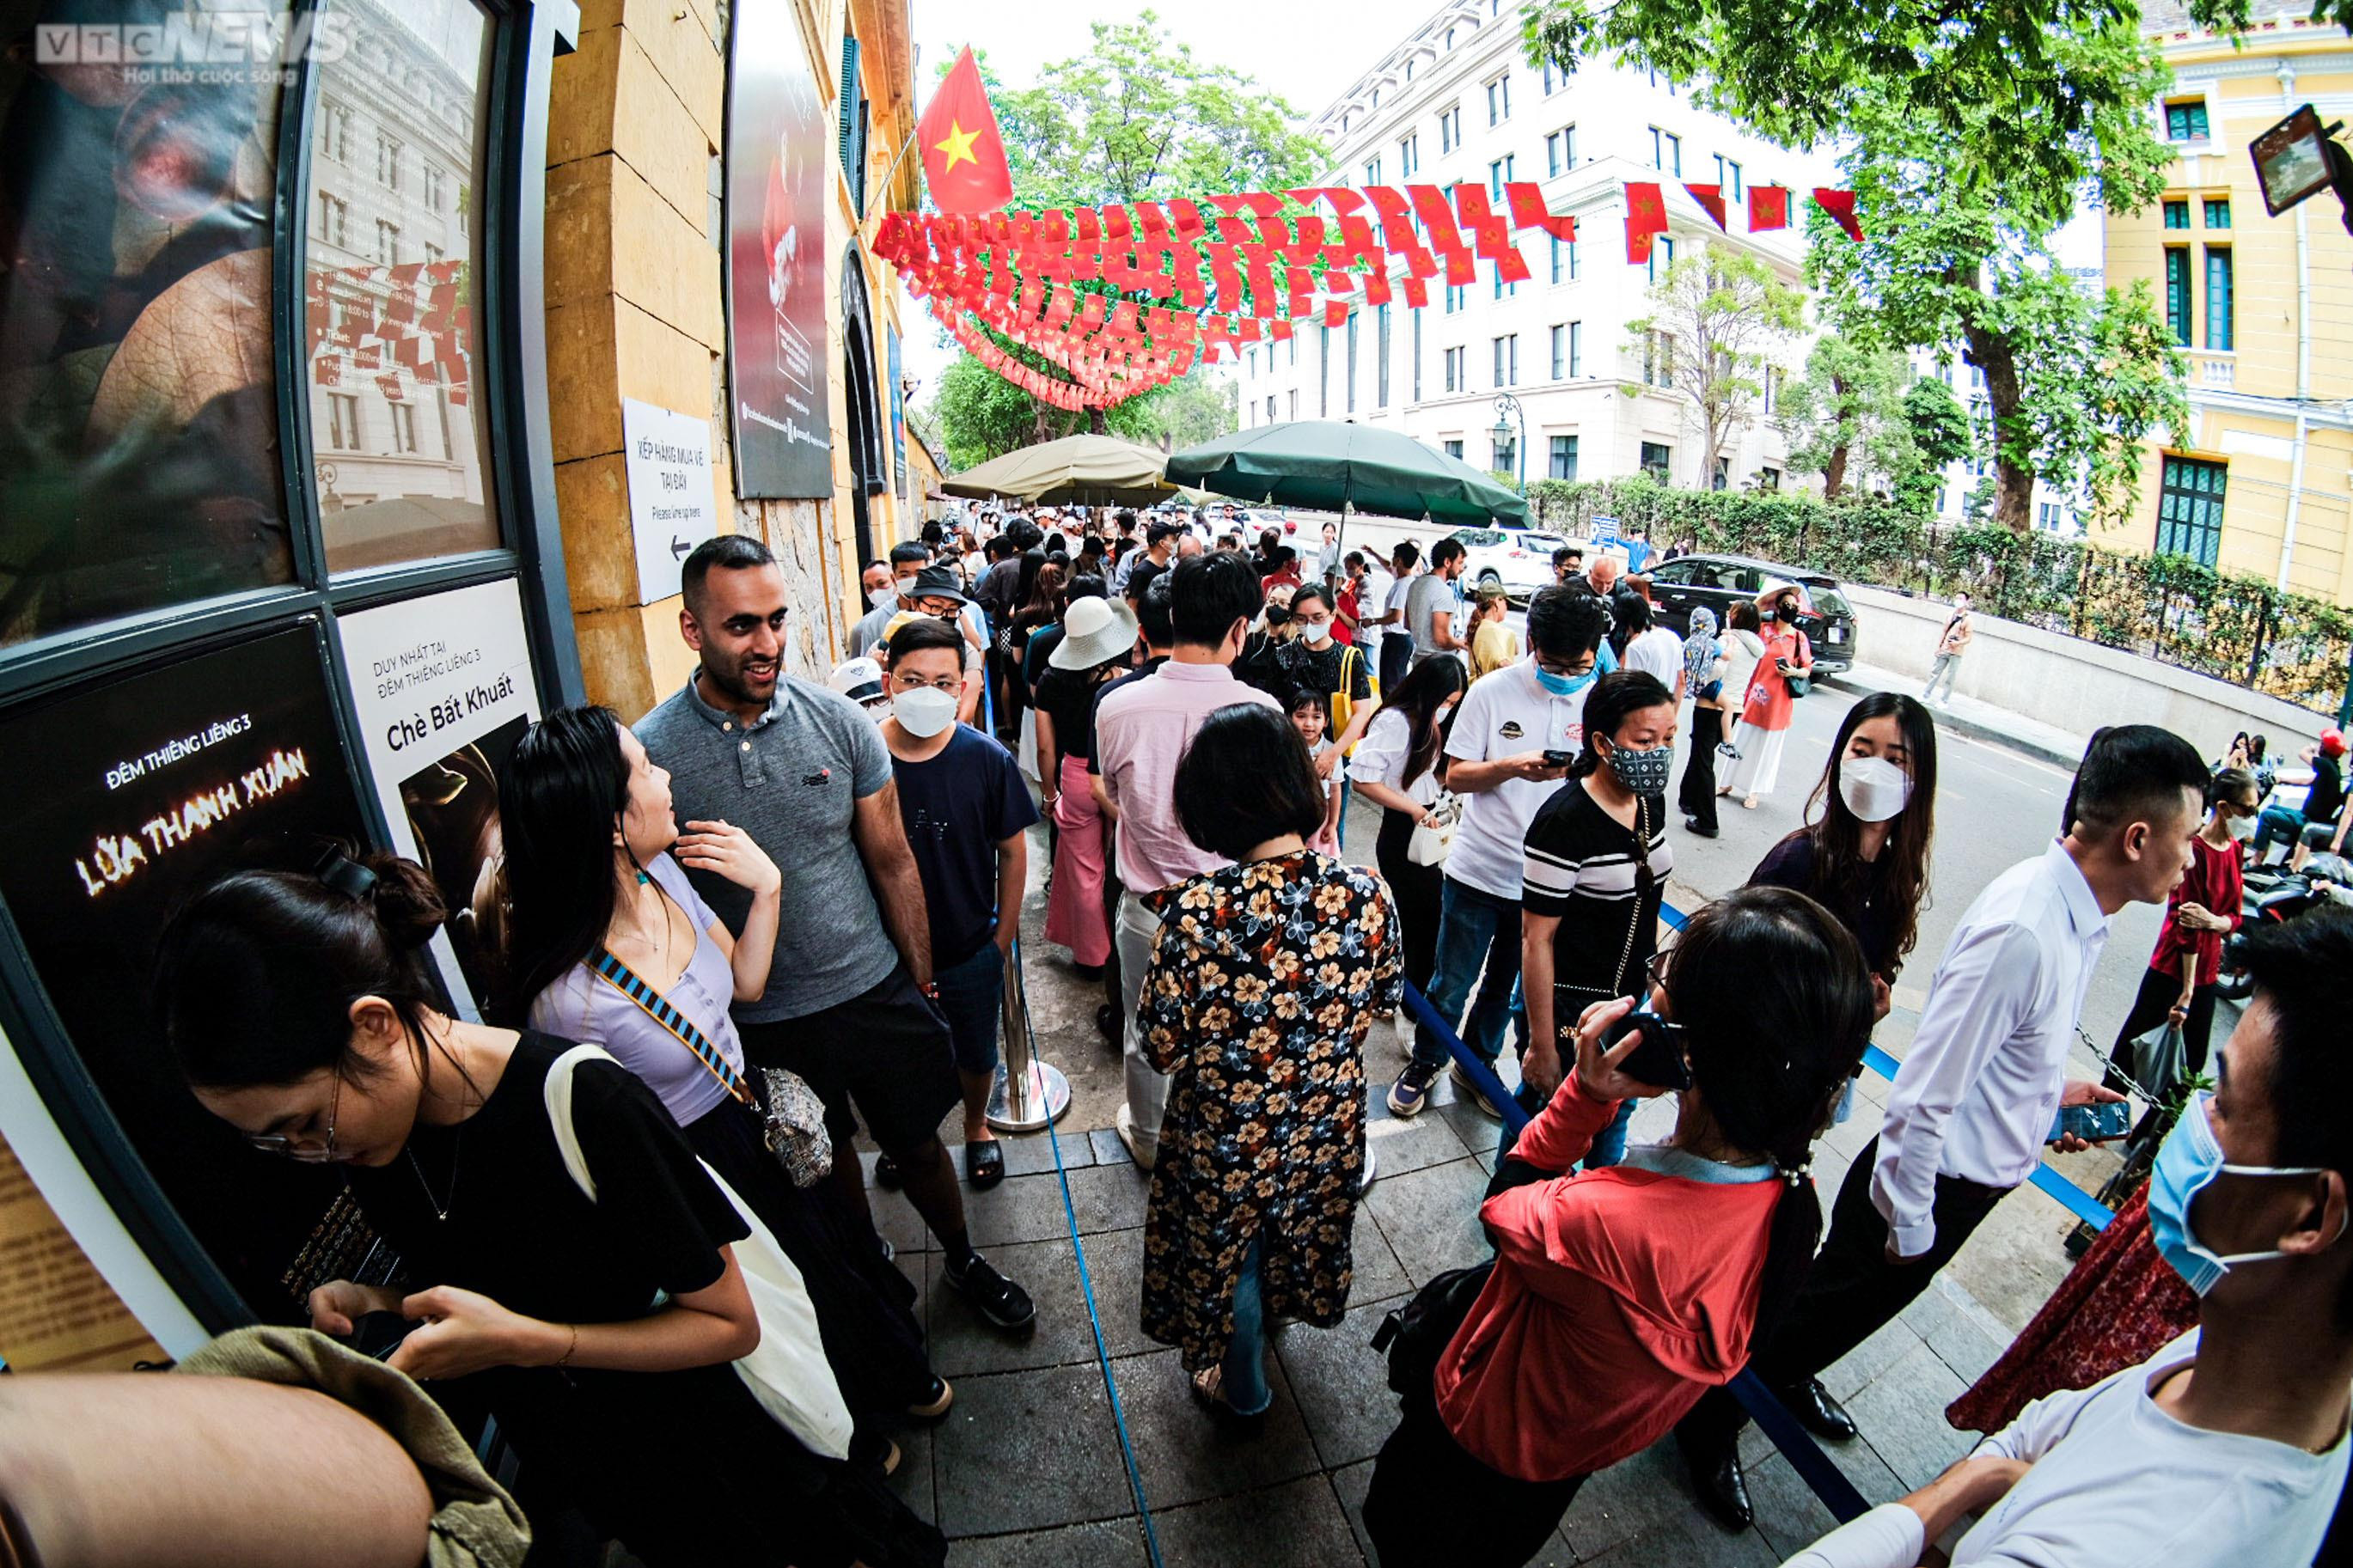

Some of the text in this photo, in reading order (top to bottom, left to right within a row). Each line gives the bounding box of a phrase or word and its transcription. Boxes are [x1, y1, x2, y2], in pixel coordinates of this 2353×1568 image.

[652, 505, 671, 521] Please
[373, 639, 447, 677] DUY NHẤT TẠI
[377, 648, 481, 699] ĐÊM THIÊNG LIÊNG 3
[387, 672, 515, 751] Chè Bất Khuất
[107, 713, 252, 790] ĐÊM THIÊNG LIÊNG 3
[141, 782, 241, 856] THANH
